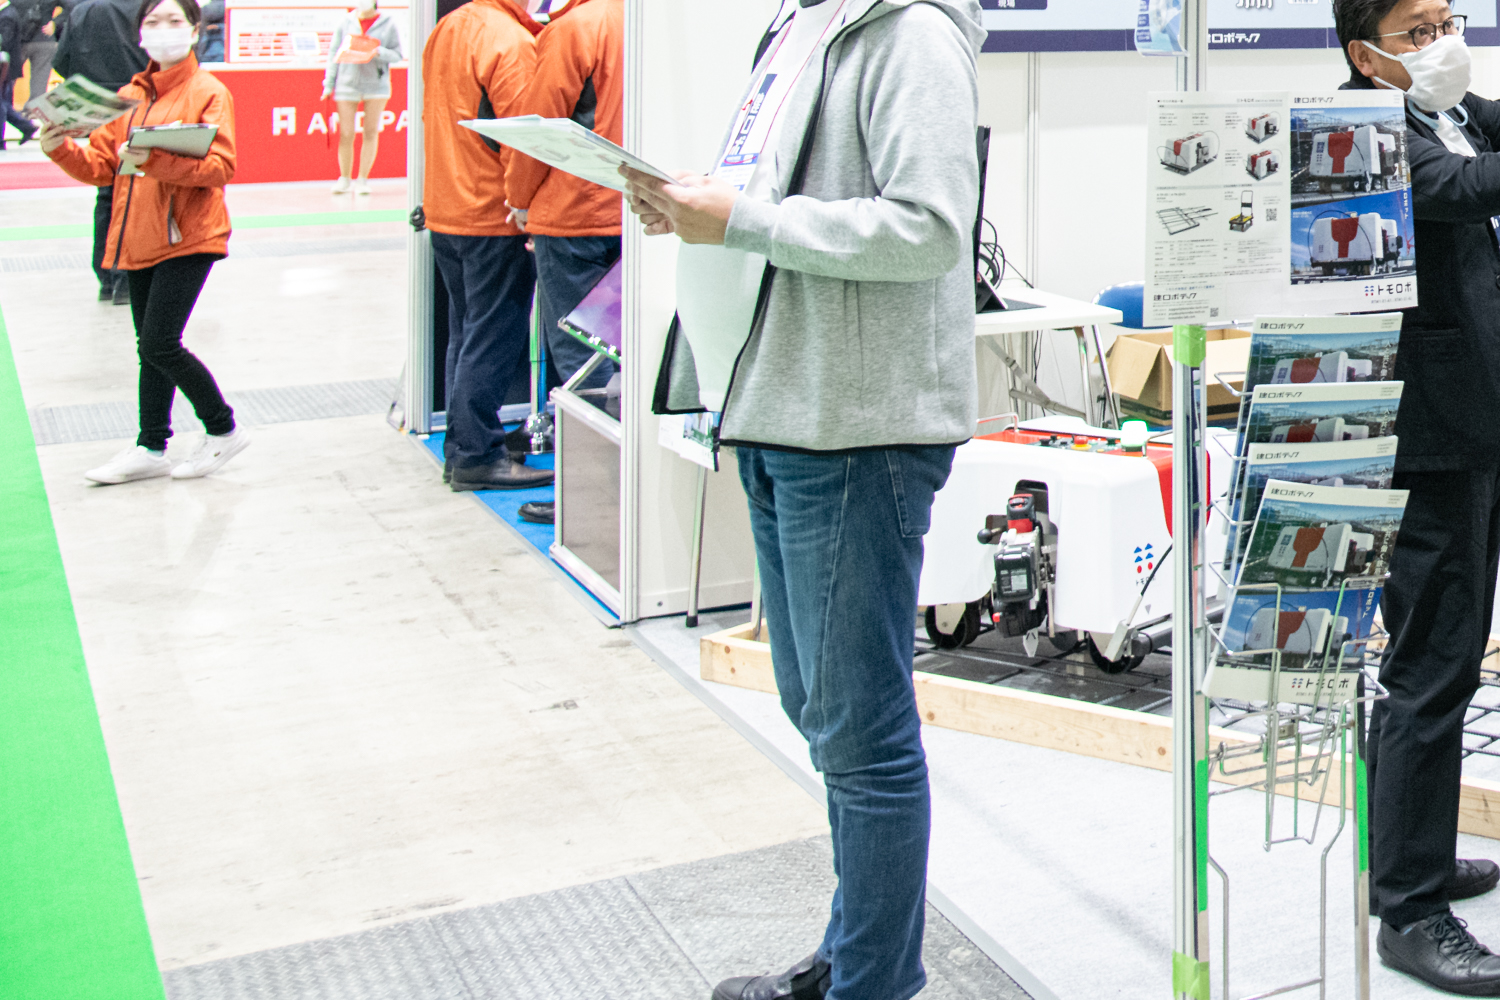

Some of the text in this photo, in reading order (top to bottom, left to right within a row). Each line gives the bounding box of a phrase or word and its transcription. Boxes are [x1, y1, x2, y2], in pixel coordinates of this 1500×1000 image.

[1293, 96, 1334, 104] 建ロボテック
[1377, 281, 1413, 296] トモロボ
[1153, 292, 1198, 302] 建ロボテック
[1260, 322, 1305, 330] 建ロボテック
[1258, 391, 1303, 399] 建ロボテック
[1256, 451, 1300, 460] 建ロボテック
[1270, 487, 1315, 498] 建ロボテック
